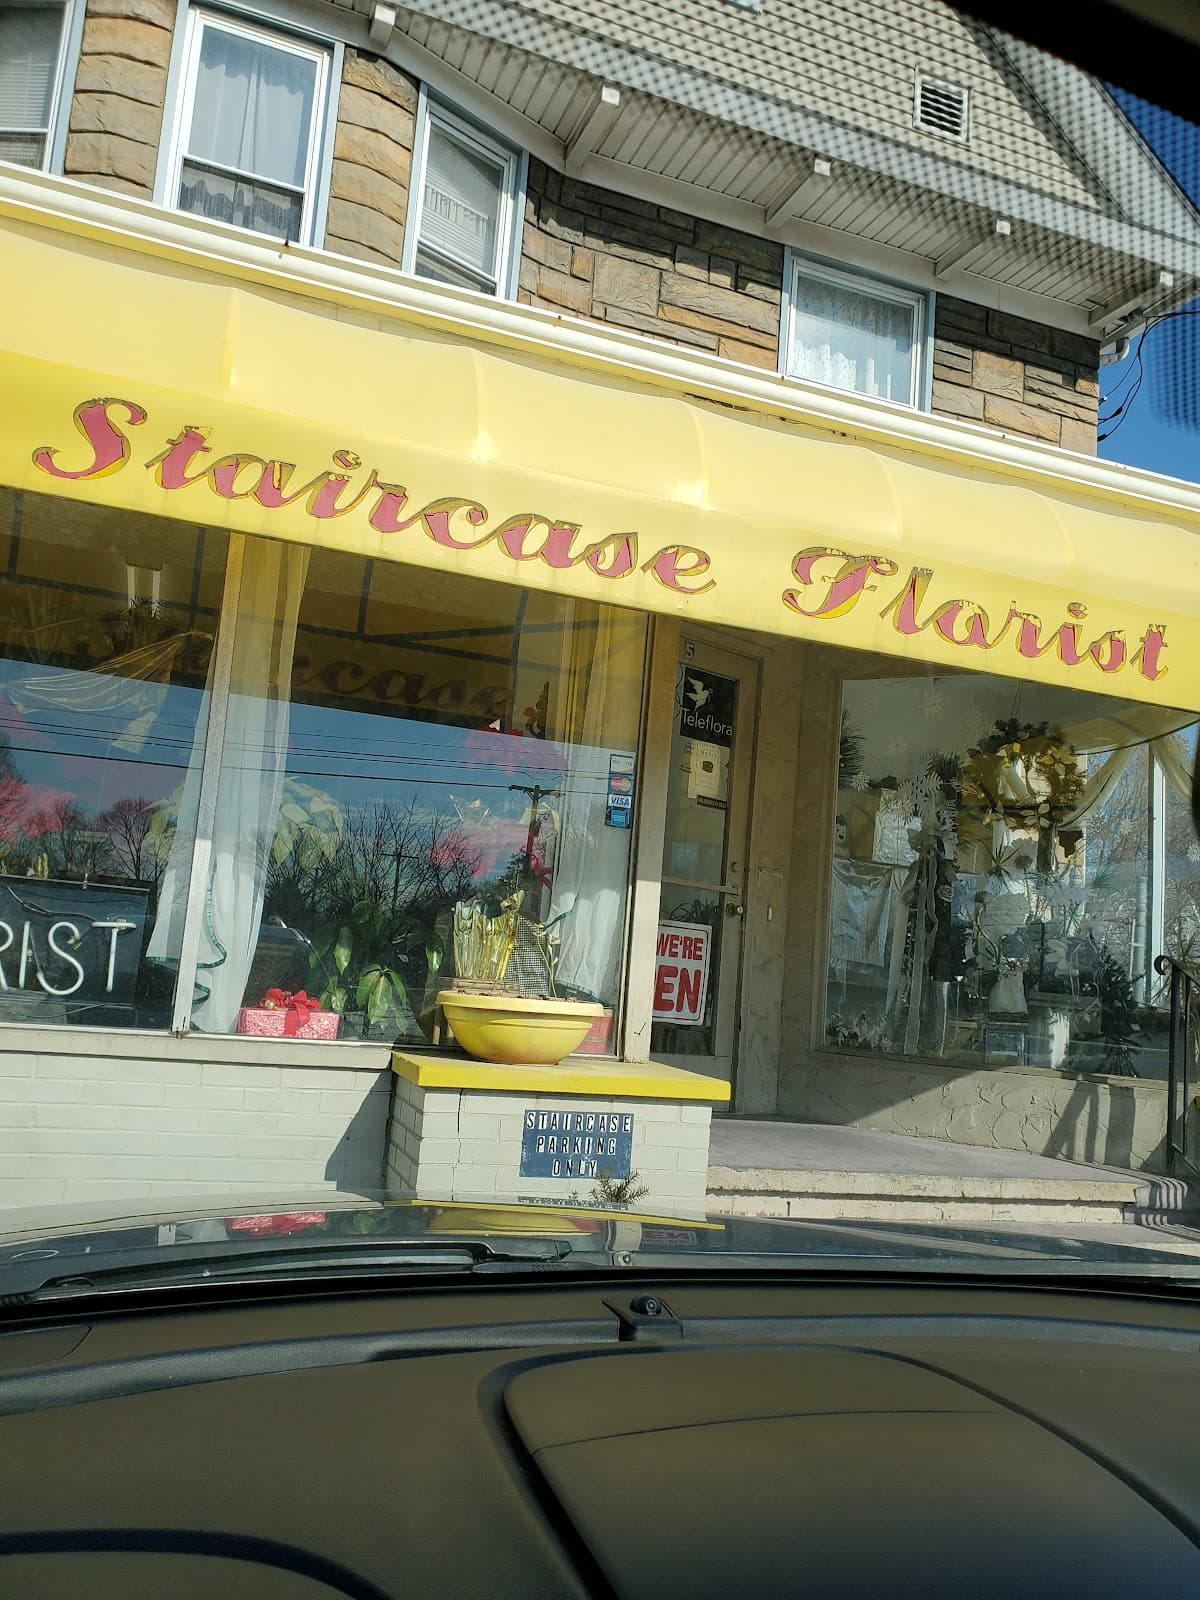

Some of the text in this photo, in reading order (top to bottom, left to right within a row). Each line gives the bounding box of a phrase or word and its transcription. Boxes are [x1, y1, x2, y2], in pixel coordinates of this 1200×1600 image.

[32, 397, 1170, 681] Staircase Florist
[680, 706, 733, 737] Teleflora
[611, 796, 630, 806] VISA
[656, 933, 704, 961] WE'RE
[653, 964, 702, 1014] EN
[526, 1111, 632, 1133] STAIRCASE
[536, 1135, 616, 1155] PARKING
[552, 1159, 598, 1177] ONLY
